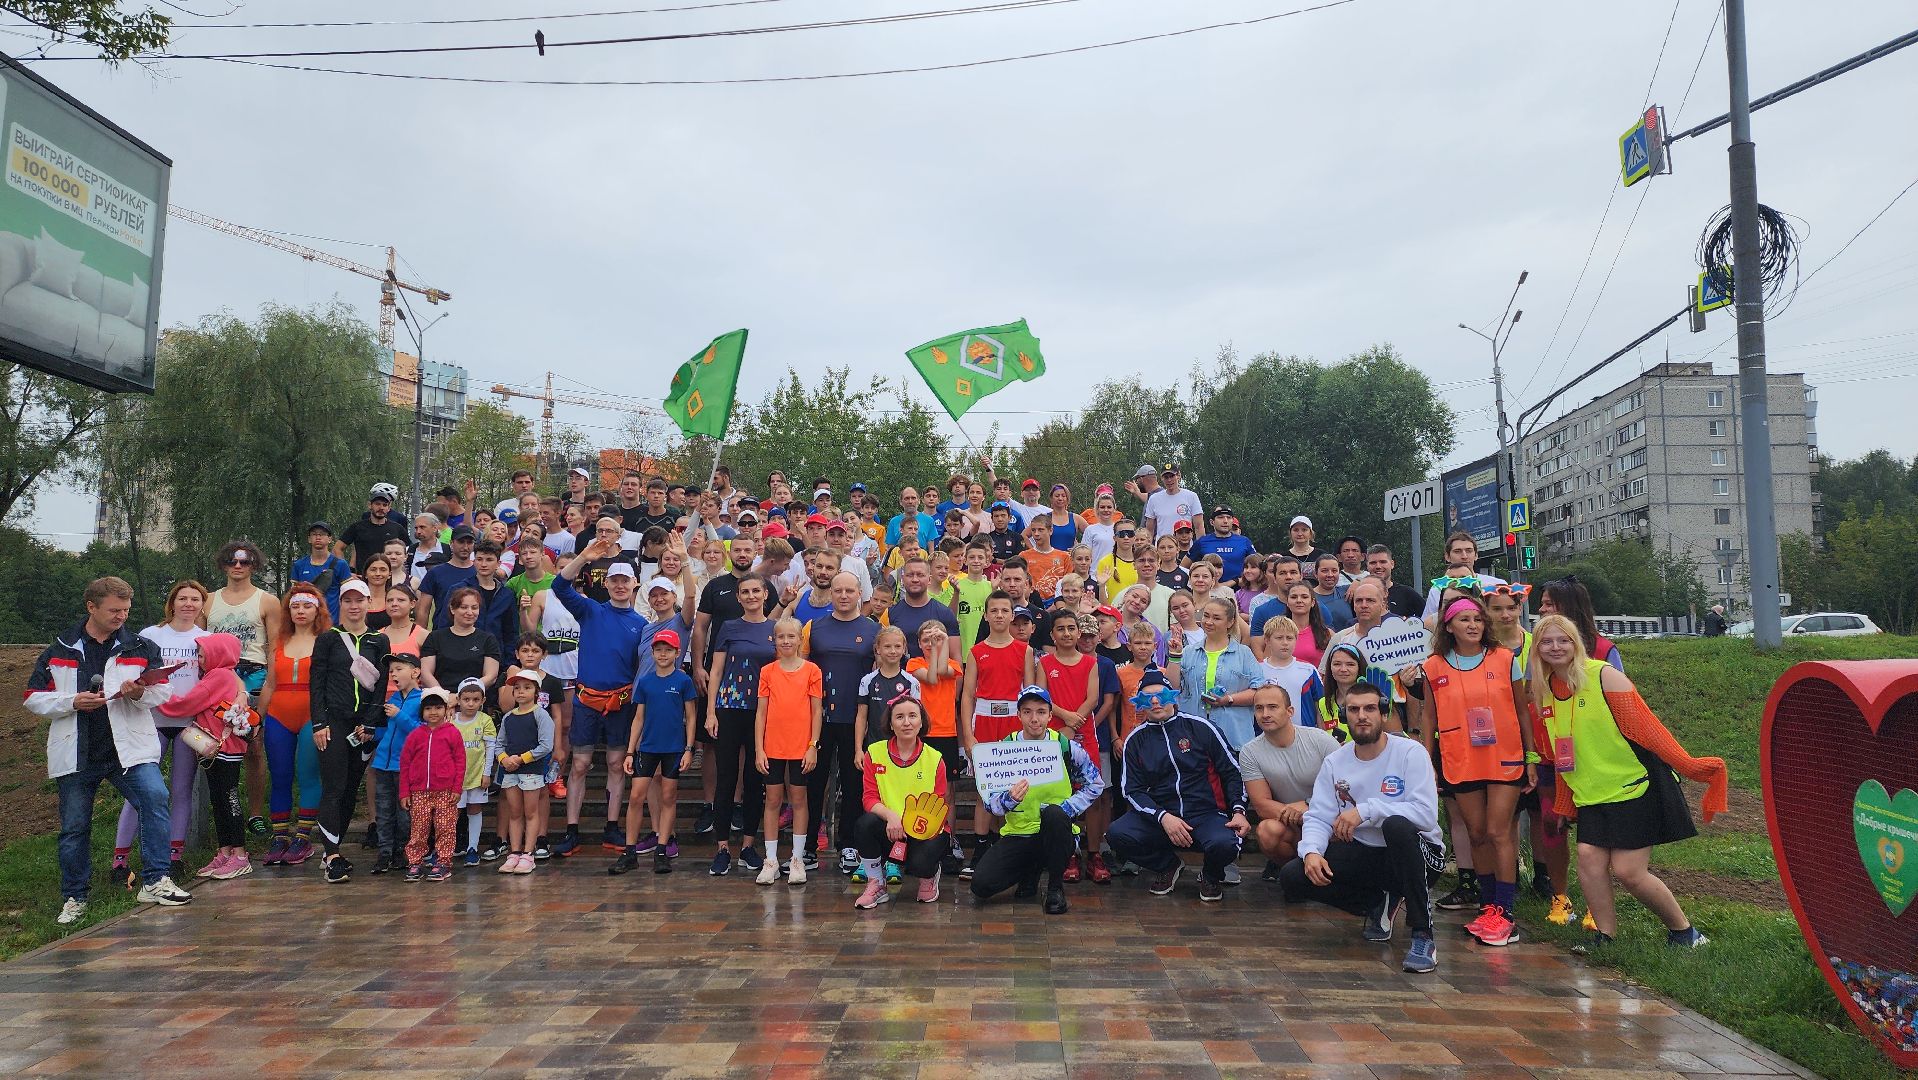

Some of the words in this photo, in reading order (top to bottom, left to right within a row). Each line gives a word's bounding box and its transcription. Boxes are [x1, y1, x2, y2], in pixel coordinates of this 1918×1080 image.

[15, 129, 73, 173] ВЫИГРАЙ
[77, 165, 148, 214] СЕРТИФИКАТ
[10, 172, 22, 187] НА
[24, 179, 62, 207] ПОКУПКИ
[64, 200, 70, 210] В
[23, 156, 48, 181] 100
[52, 174, 80, 198] 000
[94, 194, 145, 234] РУБЛЕЙ
[548, 628, 580, 639] adida
[1365, 631, 1423, 650] Пушкино
[992, 746, 1041, 757] Пушкинец,
[979, 757, 1029, 768] занимайся
[1030, 755, 1058, 764] бегом
[993, 770, 1015, 780] будь
[1017, 765, 1053, 777] здоров!
